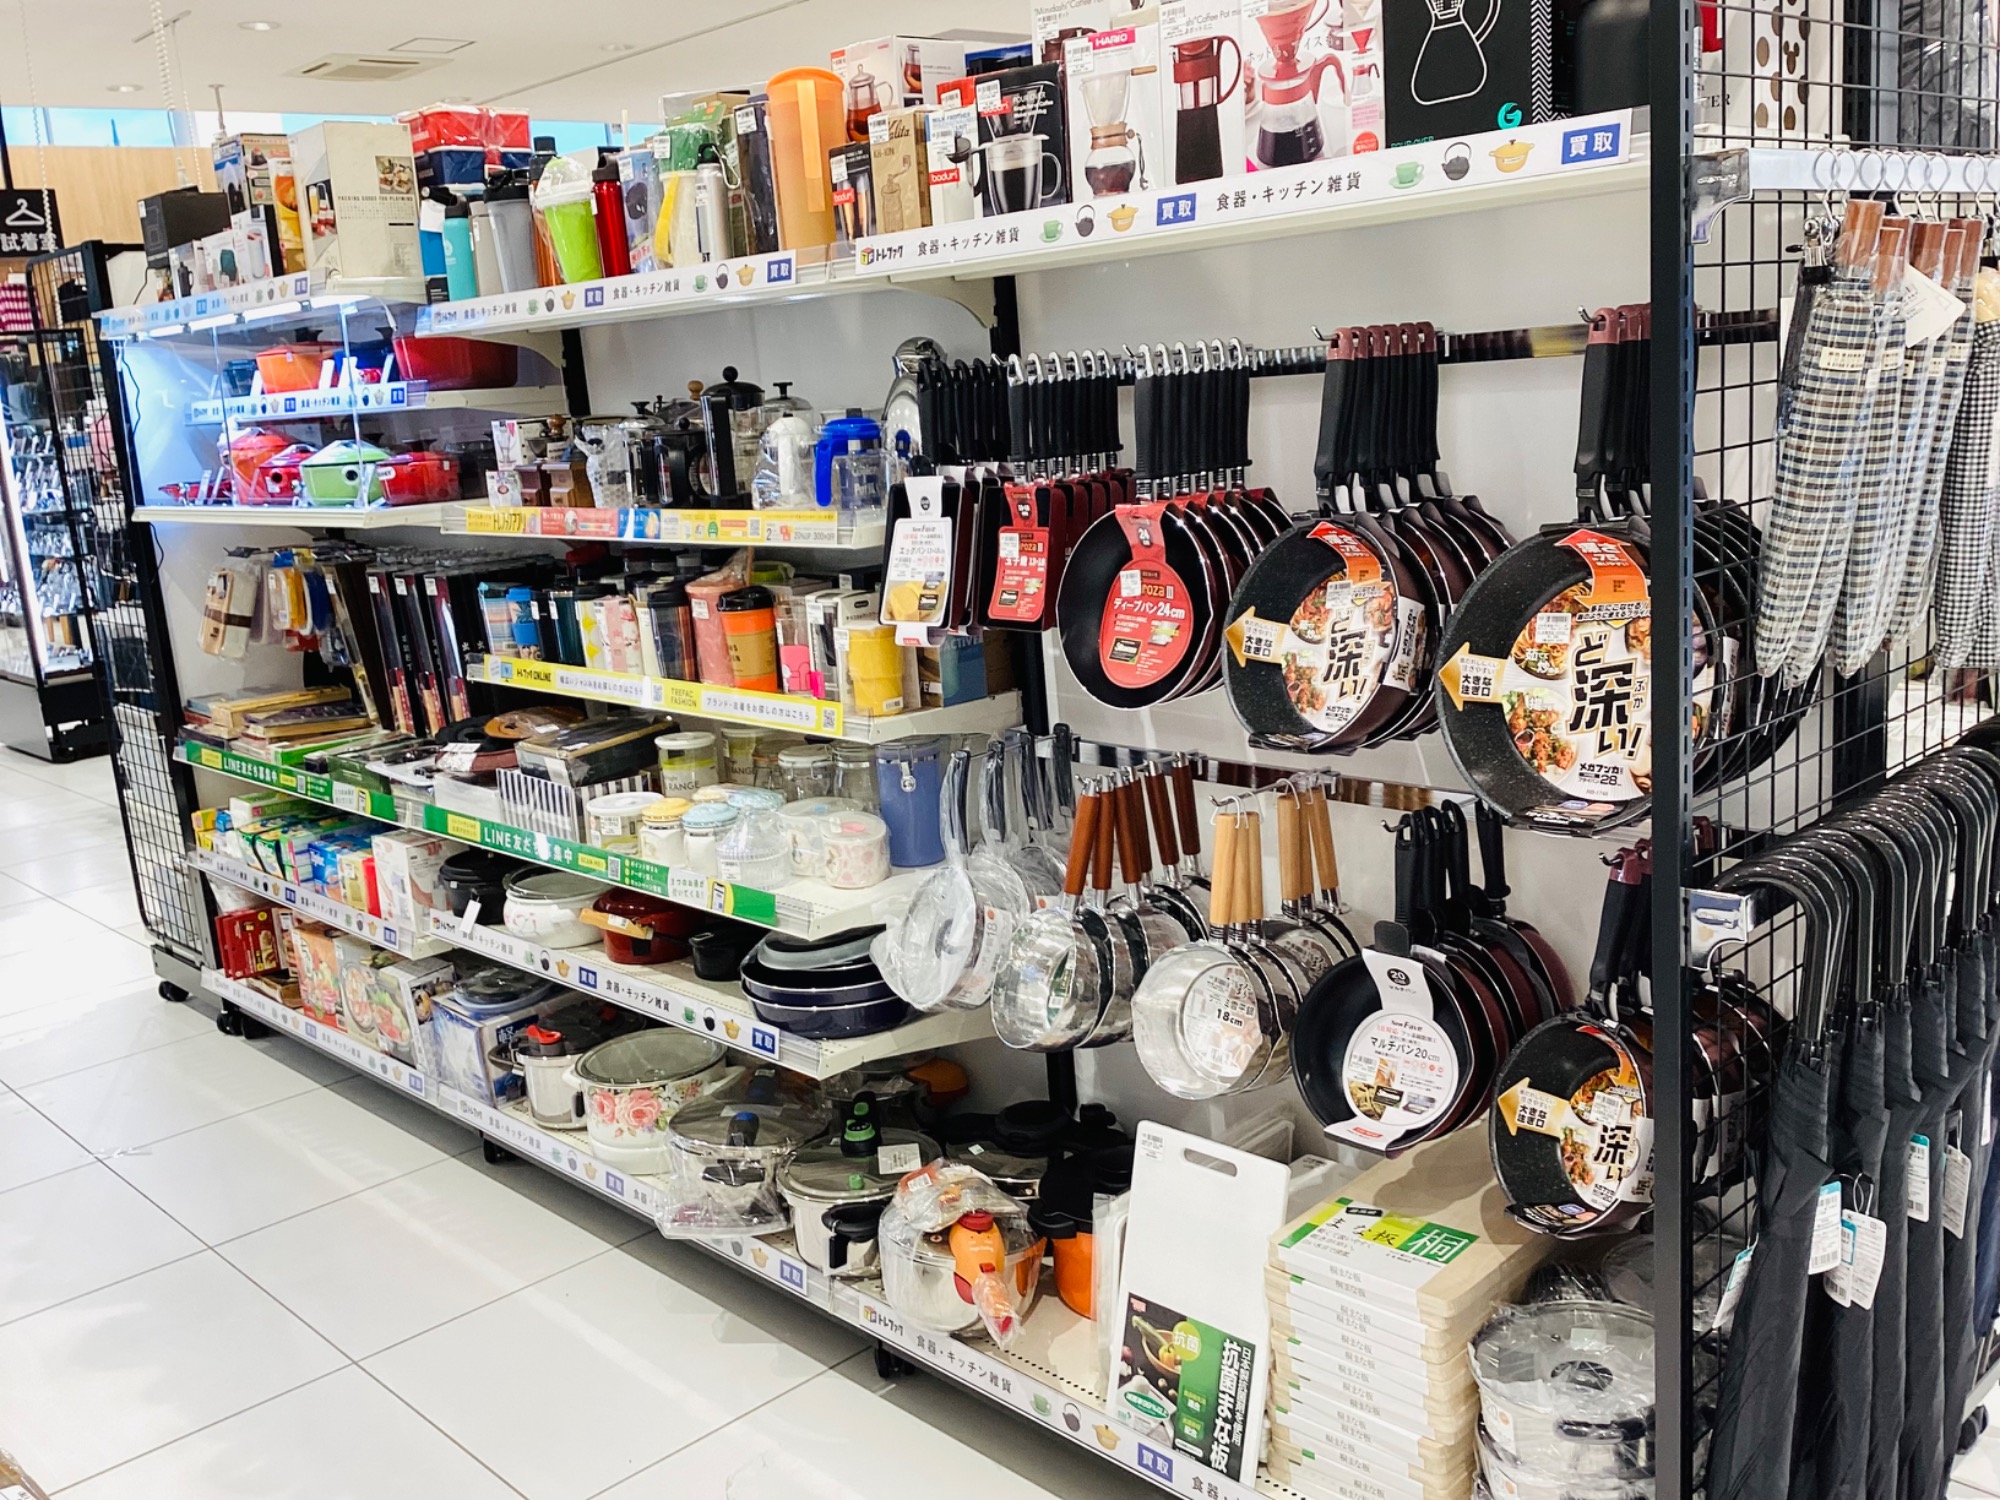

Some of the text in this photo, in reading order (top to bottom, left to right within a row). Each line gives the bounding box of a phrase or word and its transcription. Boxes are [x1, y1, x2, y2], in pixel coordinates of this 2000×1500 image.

[1095, 33, 1128, 47] HARIO
[931, 171, 958, 183] bodum
[876, 244, 903, 262] トレファク
[917, 228, 1020, 258] 食器・キッチン雑貨
[1161, 199, 1192, 220] 買取
[1216, 171, 1362, 212] 食器・キッチン雑貨
[1569, 130, 1613, 158] 買取
[587, 289, 602, 304] 買取
[770, 262, 789, 280] 買取
[1113, 597, 1186, 620] ディープパン24cm
[1244, 635, 1273, 648] 大きな
[1243, 644, 1271, 658] 注ぎ口
[534, 670, 551, 682] ONLINE
[1462, 674, 1492, 687] 大きな
[671, 687, 694, 698] TREFAC
[1461, 685, 1491, 697] 注ぎ口
[1569, 632, 1644, 757] ど深い!
[671, 695, 697, 708] FASHION
[669, 779, 700, 792] RANGE
[1600, 774, 1618, 786] 28
[484, 825, 573, 866] LINE友だ集中
[1391, 970, 1406, 980] 20
[1217, 1008, 1244, 1028] 18cm
[1370, 1036, 1440, 1063] マルチパン20cm
[1519, 1104, 1548, 1120] 大きな
[1517, 1113, 1546, 1129] 注ぎ口
[1407, 1228, 1470, 1263] 桐
[783, 1264, 801, 1286] 買取
[1174, 1330, 1200, 1354] 抗菌
[916, 1334, 1013, 1396] 食器・キッチン雑貨
[1142, 1450, 1169, 1476] 買取
[1210, 1338, 1242, 1473] 抗菌まな板
